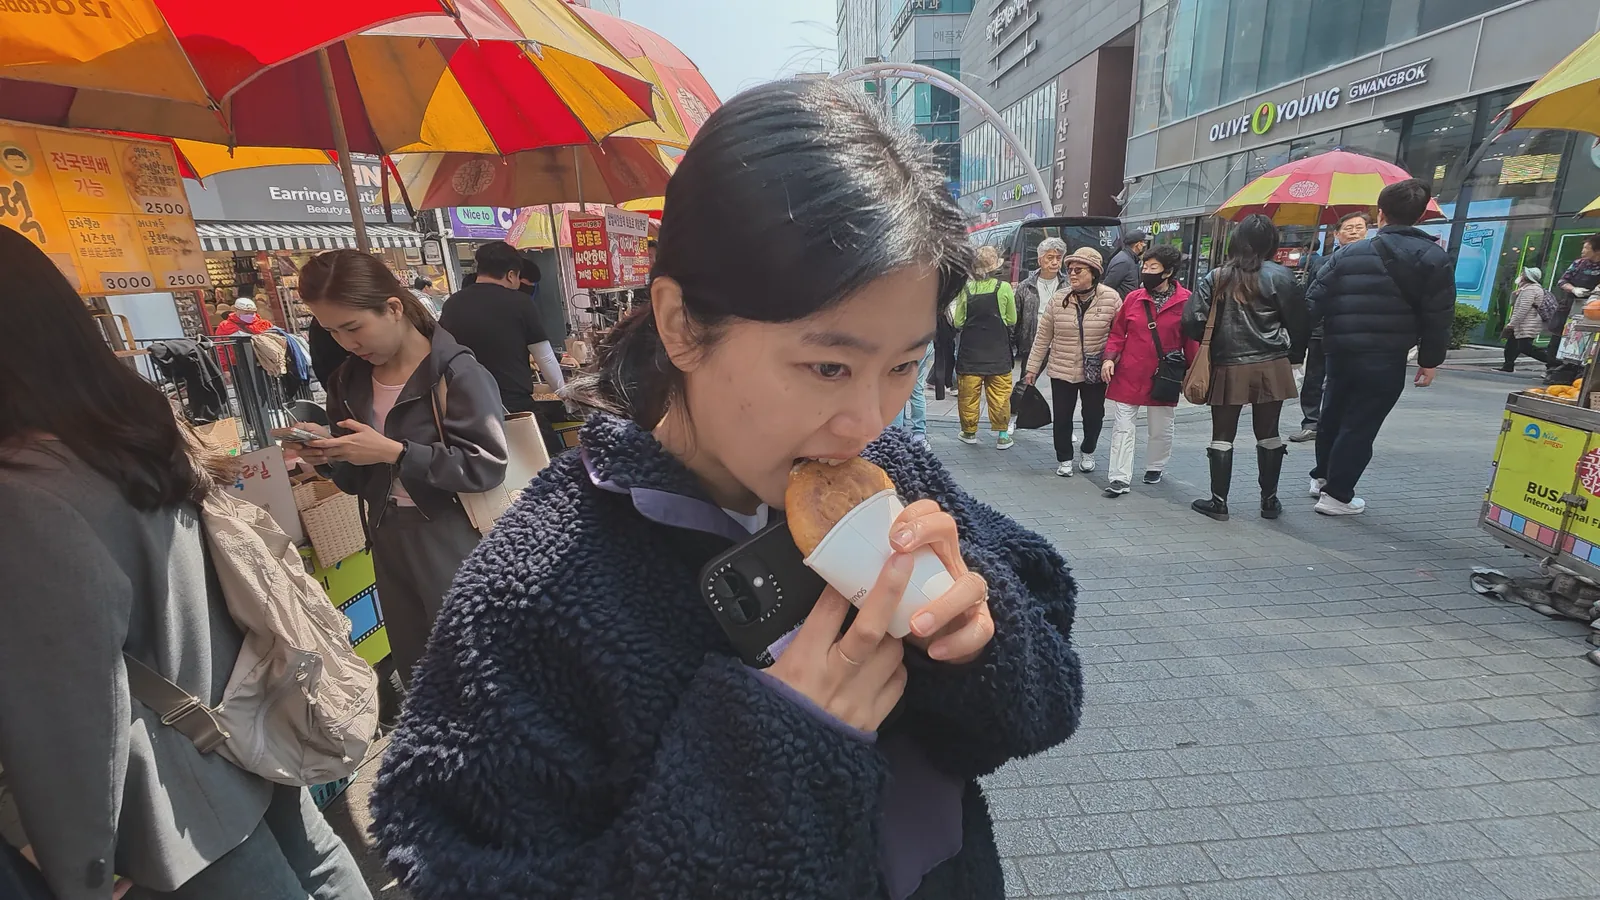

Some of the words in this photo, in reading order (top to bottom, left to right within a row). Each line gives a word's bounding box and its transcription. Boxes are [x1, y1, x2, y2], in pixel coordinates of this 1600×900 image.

[1208, 115, 1252, 142] OLIVE
[1276, 87, 1340, 124] YOUNG
[1349, 64, 1428, 99] GWANGBOK
[1055, 88, 1070, 200] 부산극장
[51, 151, 111, 174] 전국택배
[73, 178, 105, 198] 가능
[268, 186, 332, 203] Earring
[145, 202, 184, 214] 2500
[306, 204, 343, 218] Beauty
[462, 208, 481, 220] Nice
[482, 212, 490, 221] to
[106, 276, 151, 290] 3000
[168, 274, 205, 286] 2500
